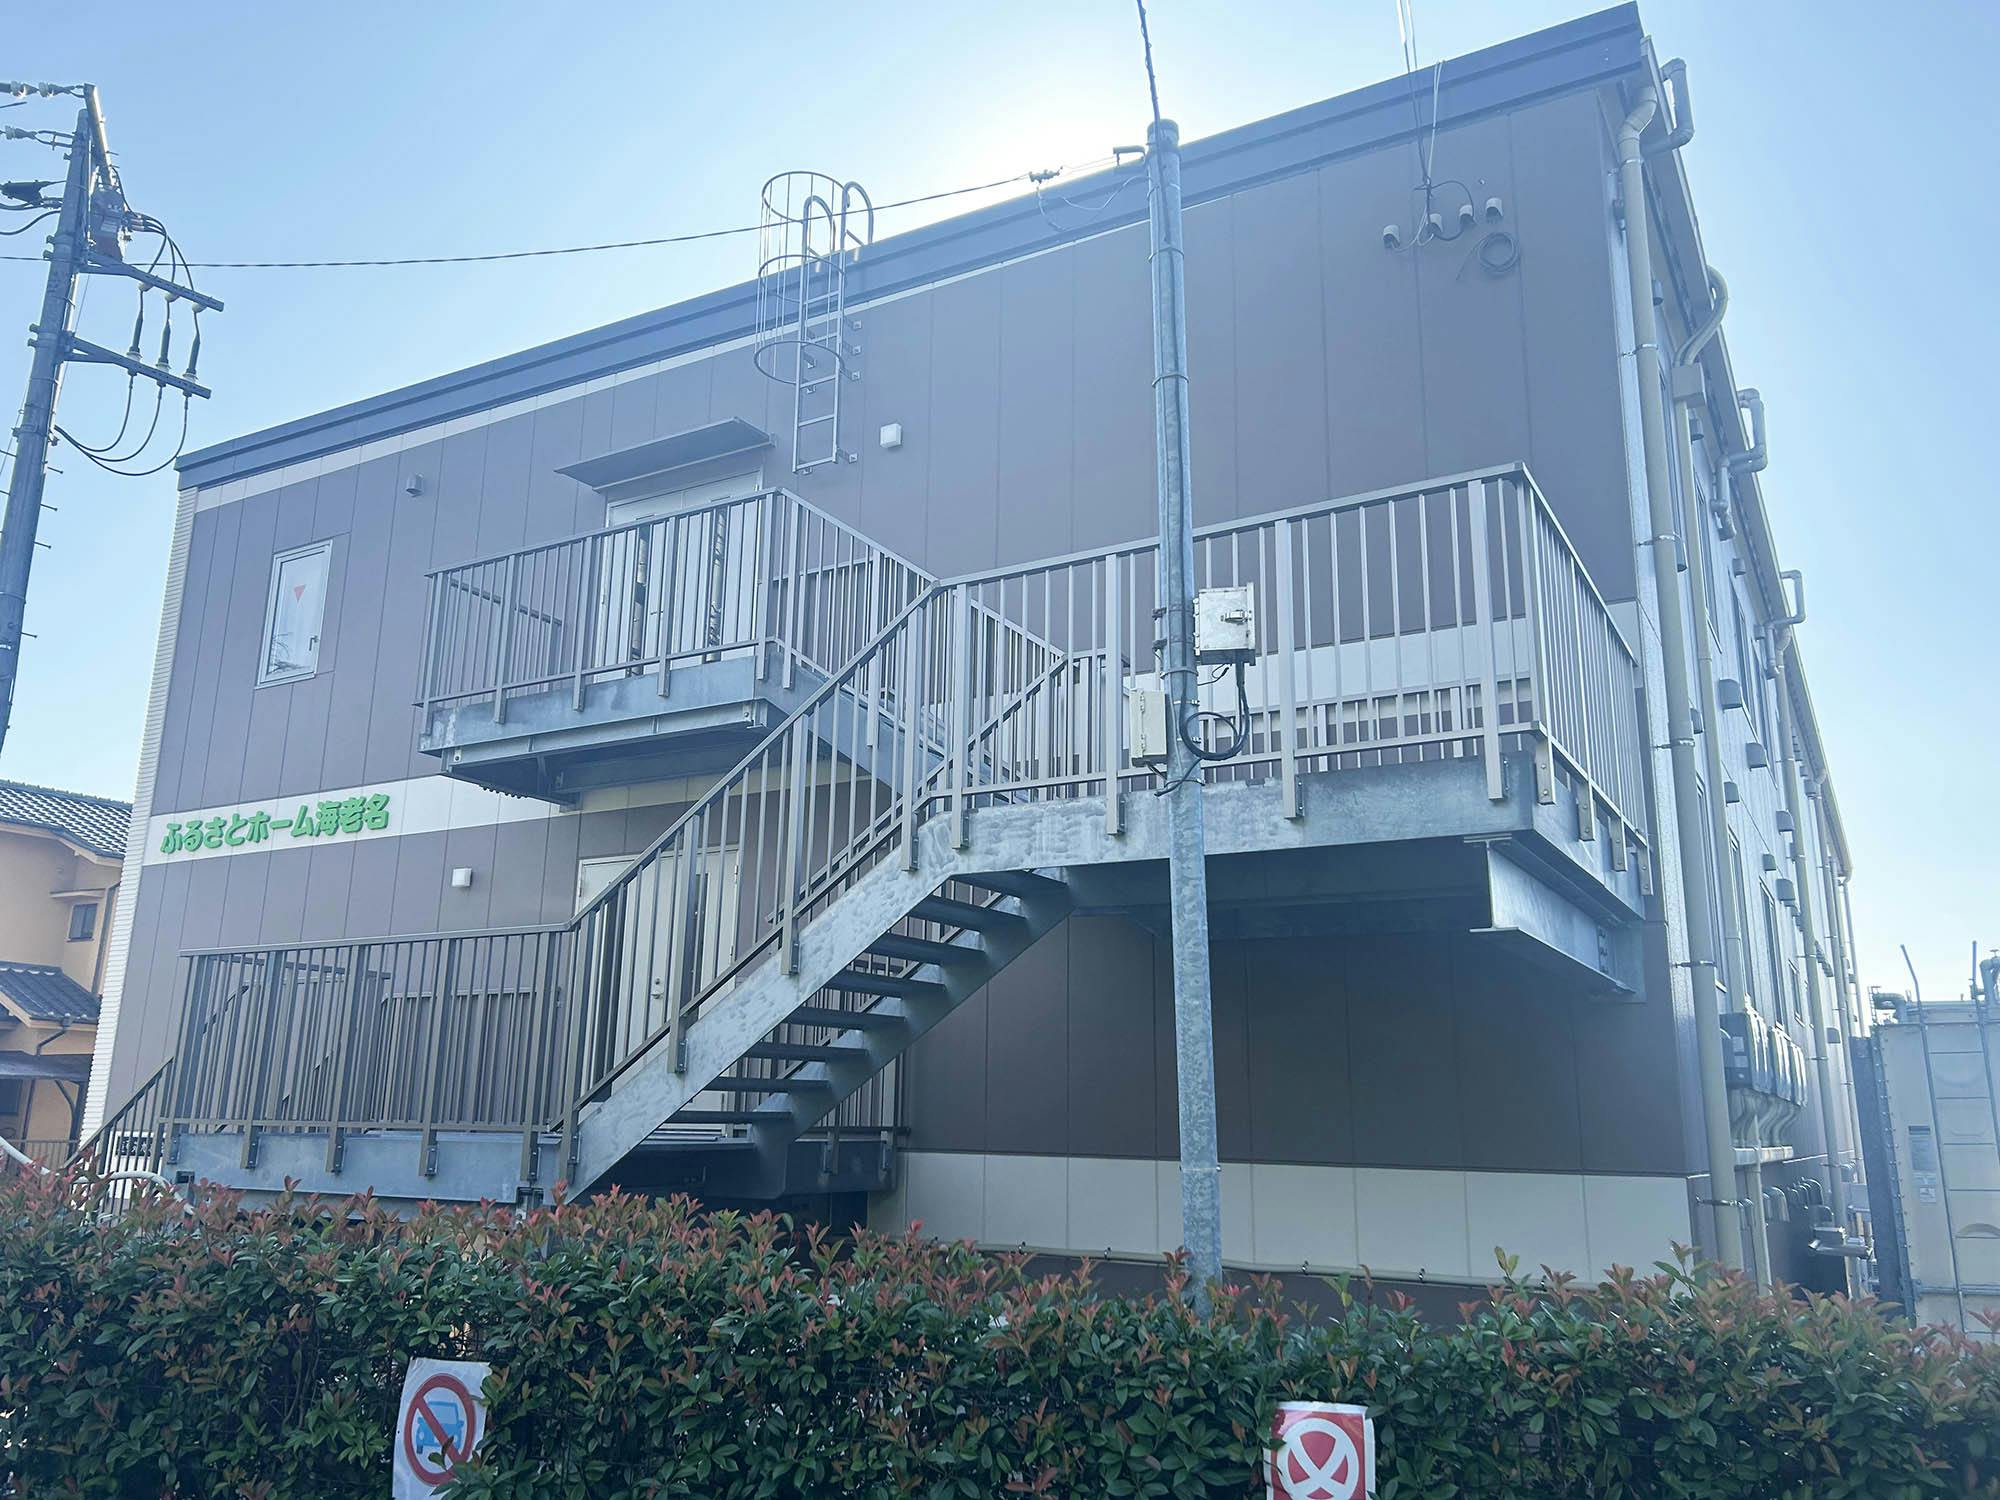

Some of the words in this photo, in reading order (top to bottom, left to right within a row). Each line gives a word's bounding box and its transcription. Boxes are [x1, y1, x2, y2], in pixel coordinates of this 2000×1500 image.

[160, 793, 390, 854] ふるさとホーム海老名
